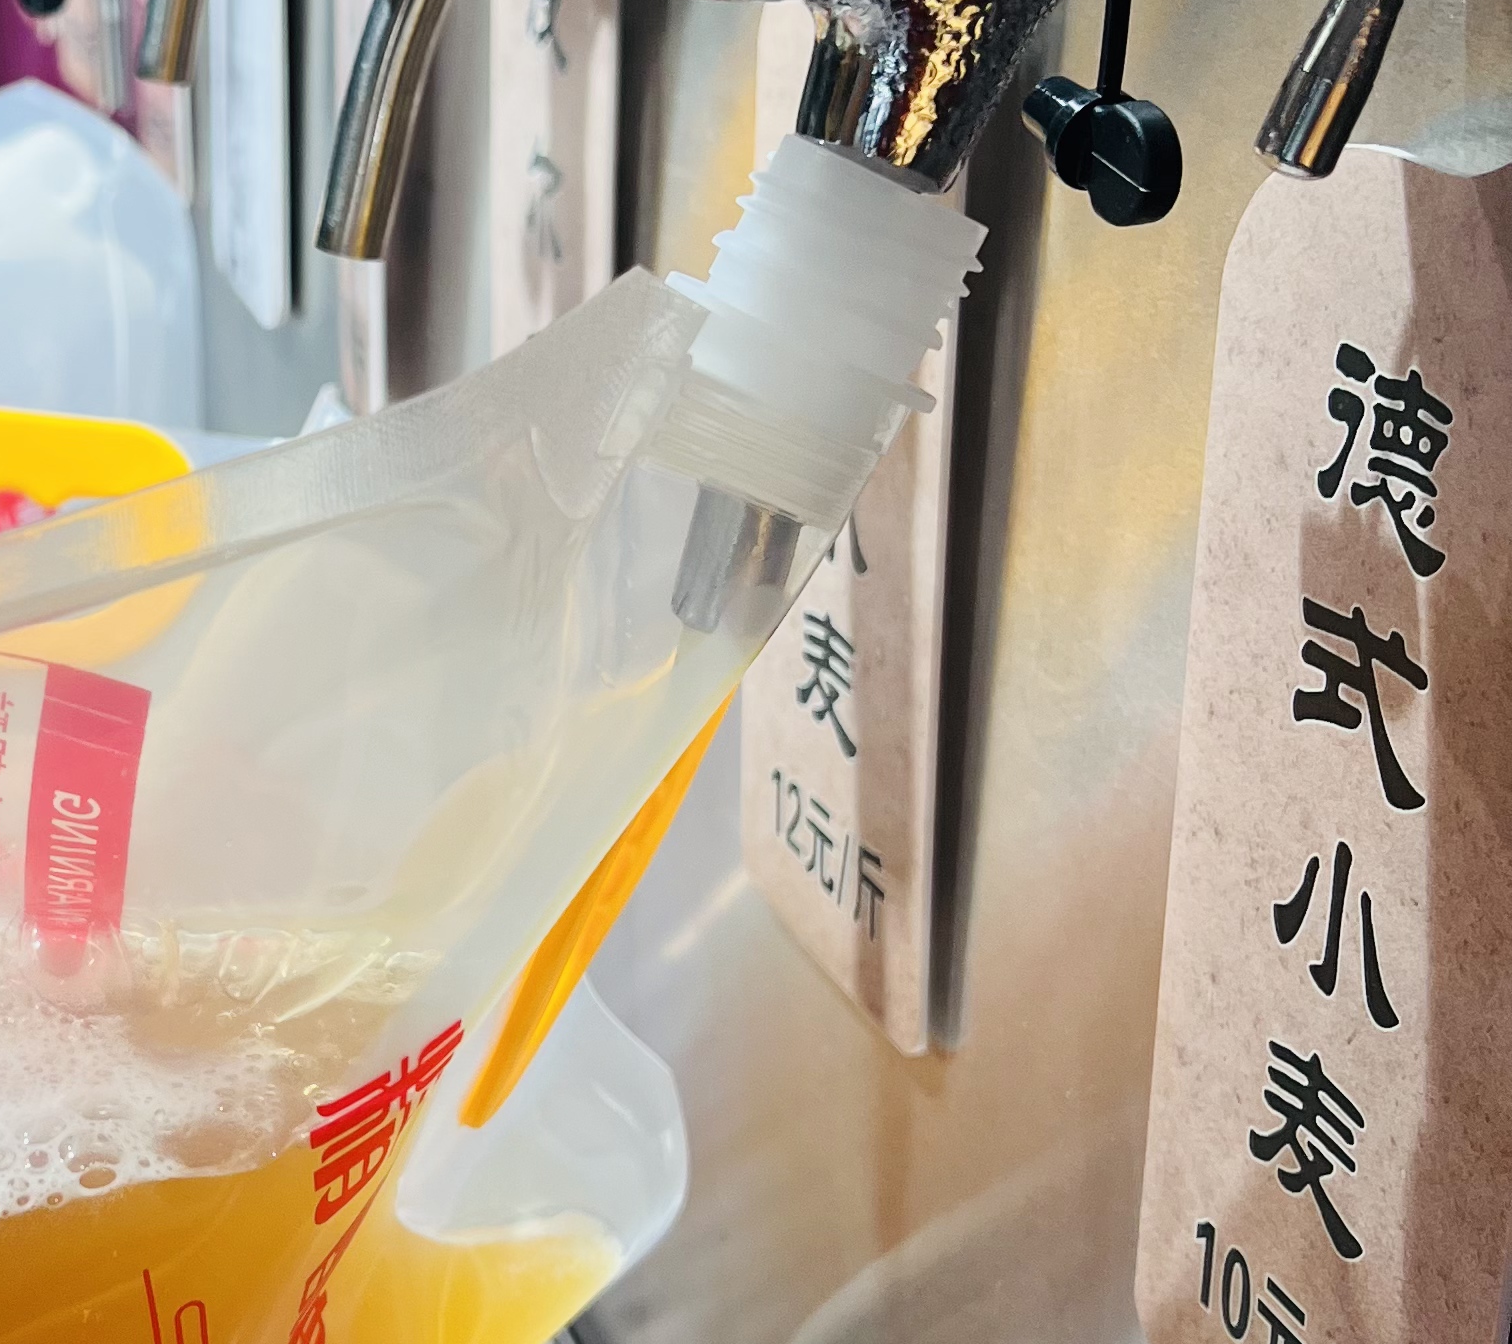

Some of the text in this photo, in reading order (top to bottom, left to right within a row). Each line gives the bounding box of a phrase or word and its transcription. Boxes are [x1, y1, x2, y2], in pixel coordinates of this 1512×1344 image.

[796, 512, 868, 759] 麦
[771, 768, 886, 942] 12元/斤
[1249, 340, 1454, 1260] 德式小麦
